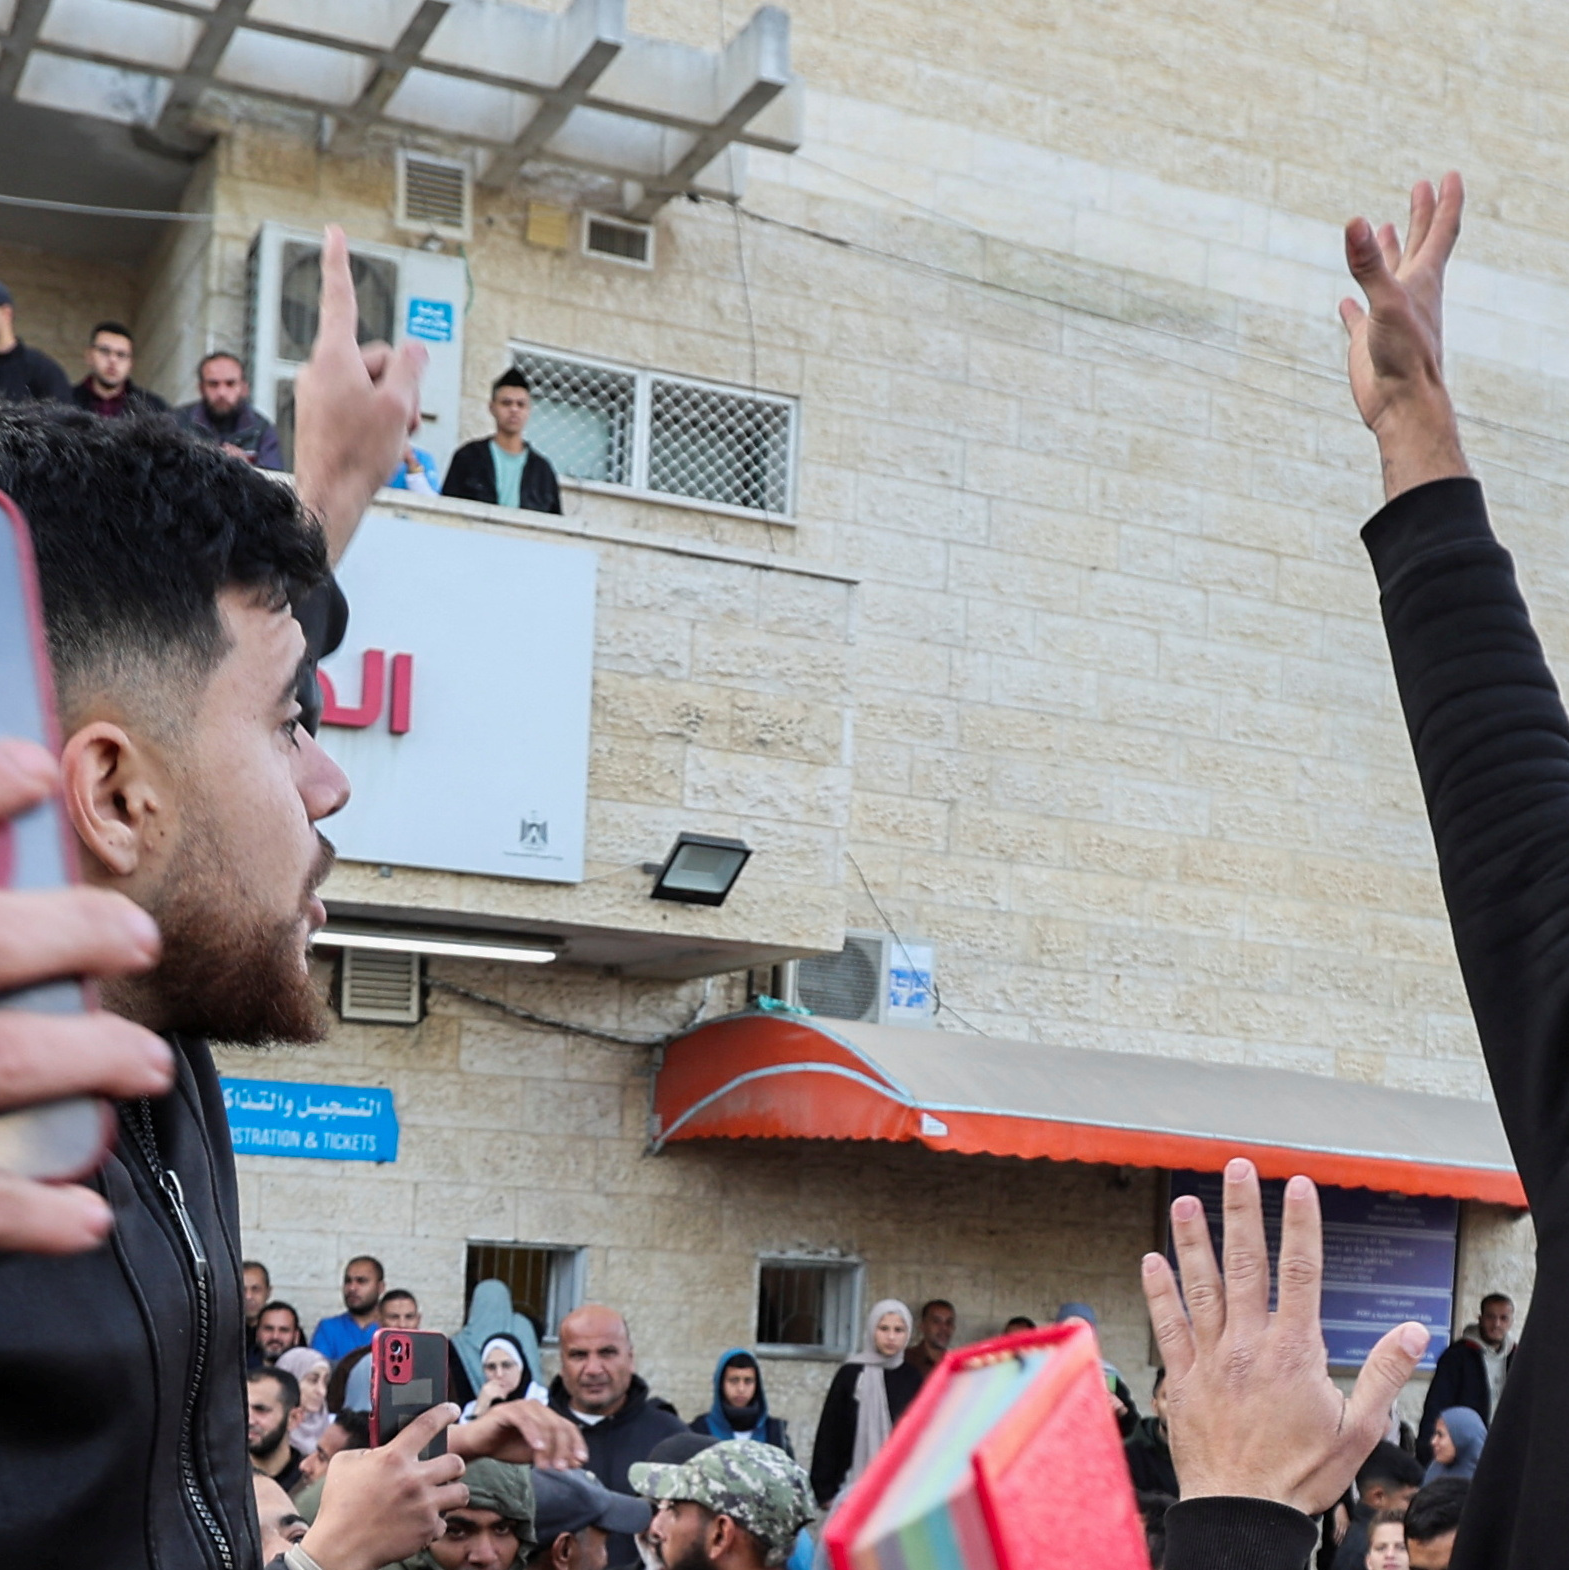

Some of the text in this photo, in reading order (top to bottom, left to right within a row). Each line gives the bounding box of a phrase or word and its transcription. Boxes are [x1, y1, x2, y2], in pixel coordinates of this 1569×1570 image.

[297, 1094, 381, 1121] التسجيل
[303, 1131, 319, 1149] &
[323, 1132, 377, 1152] TICKETS
